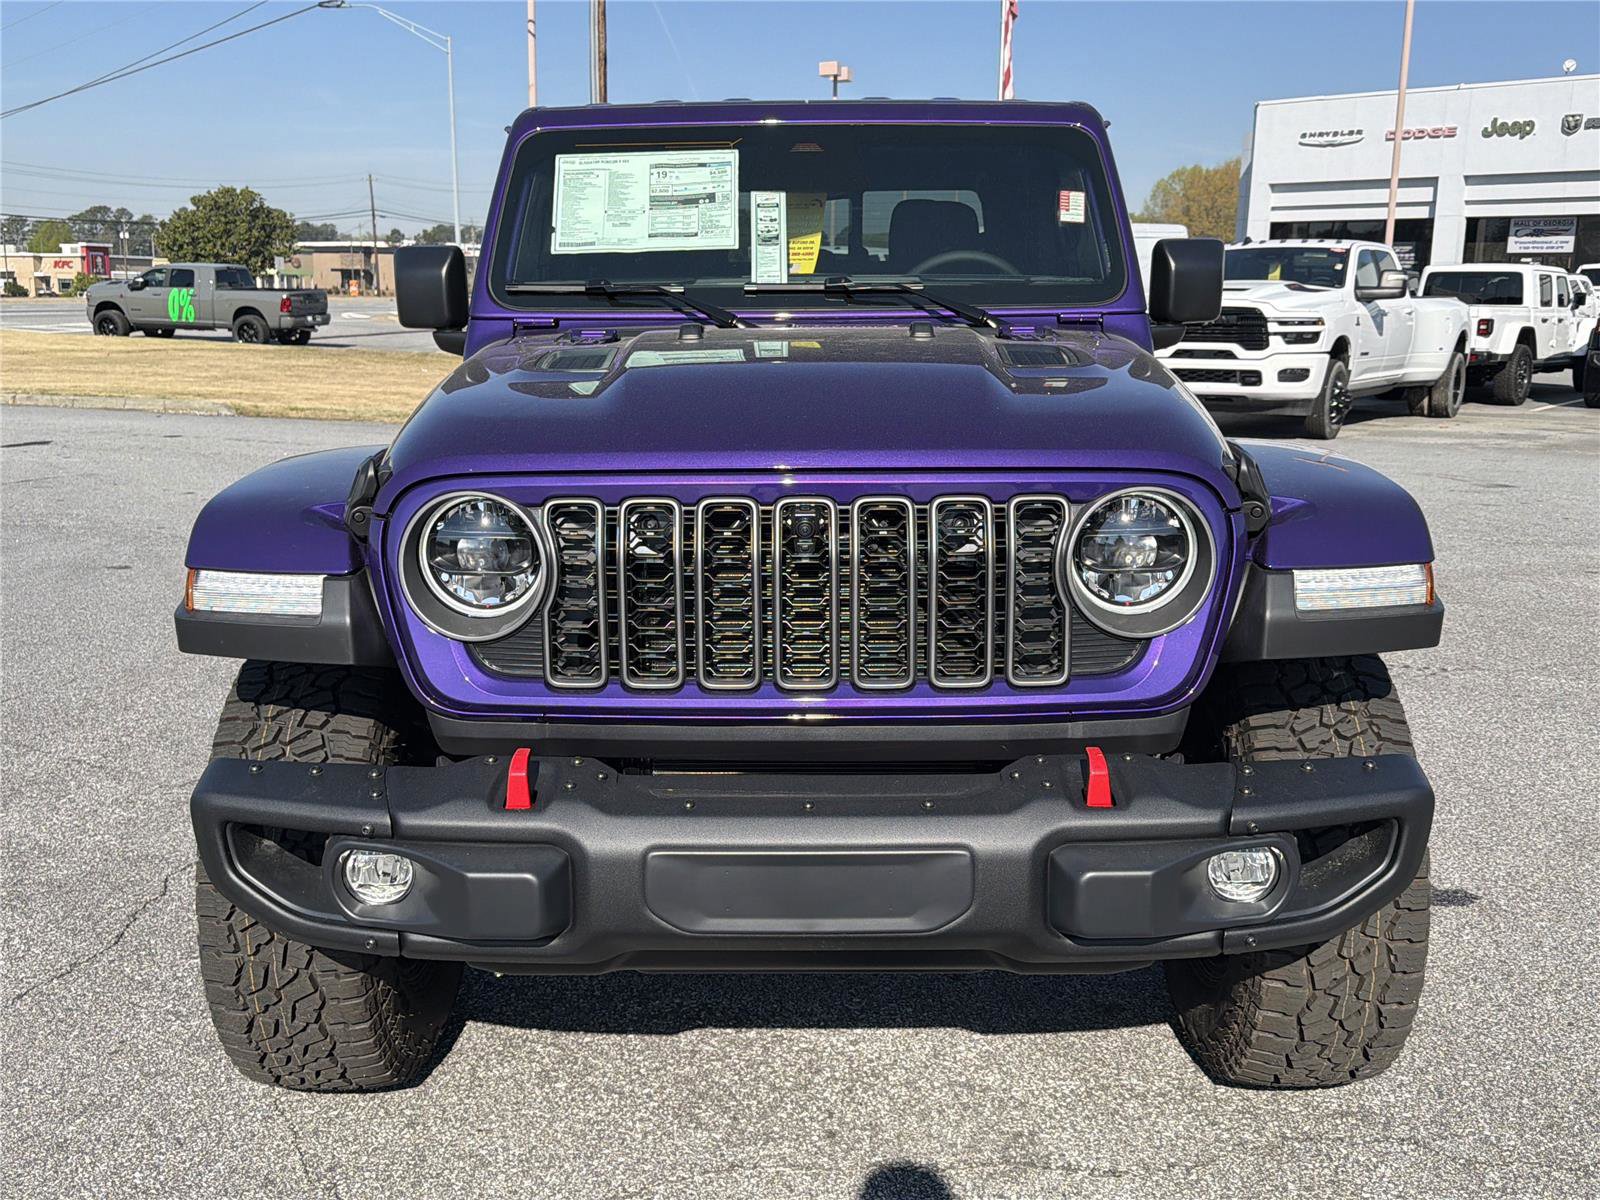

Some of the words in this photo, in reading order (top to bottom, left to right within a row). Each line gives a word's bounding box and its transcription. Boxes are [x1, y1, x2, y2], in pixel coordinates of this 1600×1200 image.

[1481, 117, 1535, 140] Jeep
[1300, 129, 1364, 139] CHRYSLER
[1385, 126, 1458, 142] DODGE
[656, 170, 668, 179] 19
[1514, 219, 1531, 227] MALL
[1532, 219, 1541, 227] OF
[1543, 218, 1575, 227] GEORGIA
[53, 260, 73, 269] KFC
[168, 287, 195, 322] 0%
